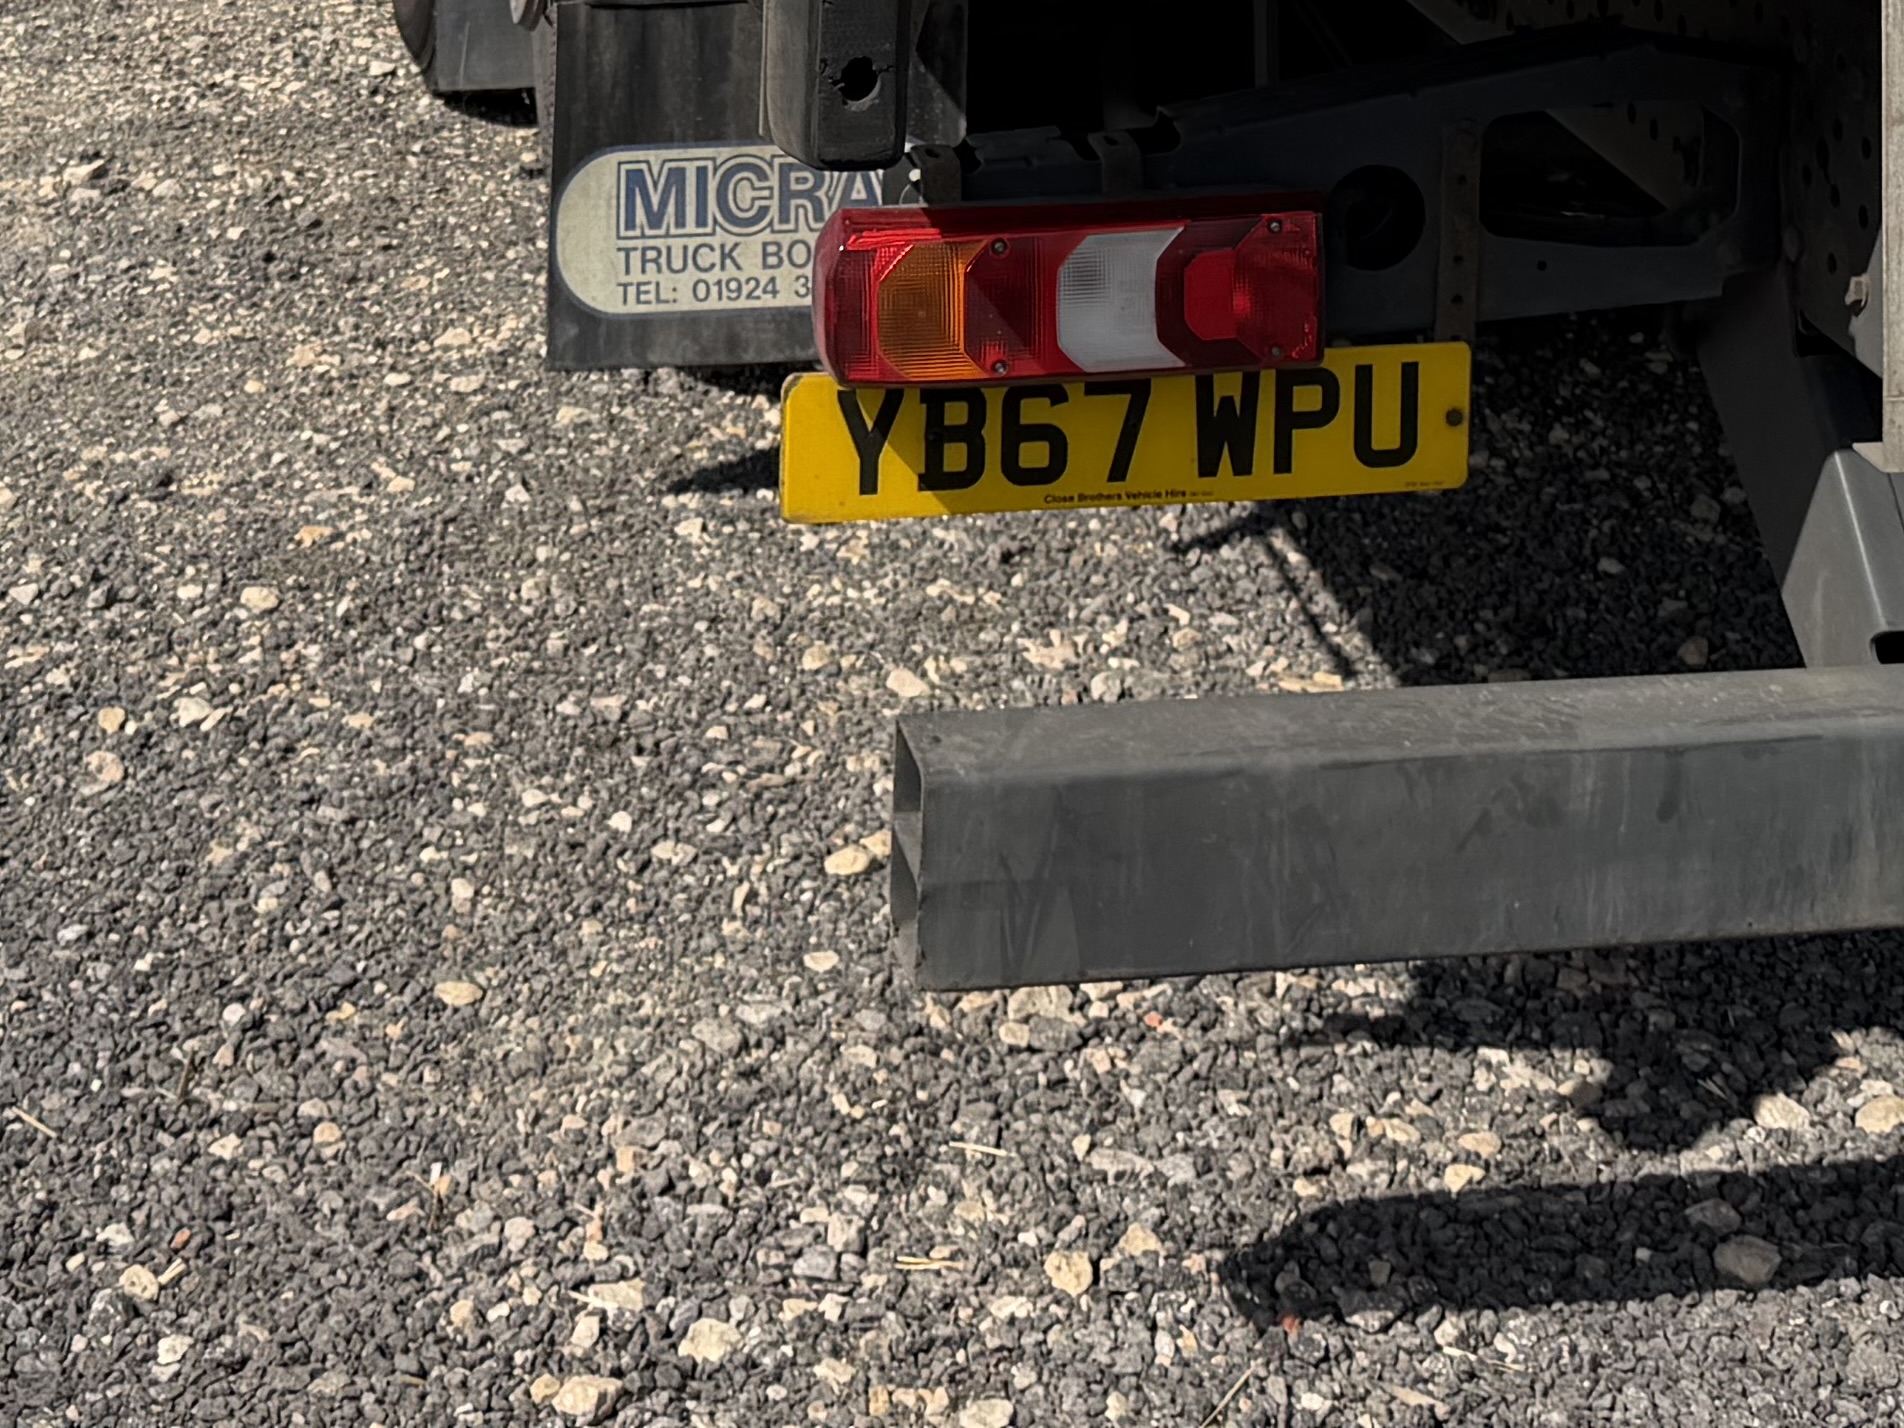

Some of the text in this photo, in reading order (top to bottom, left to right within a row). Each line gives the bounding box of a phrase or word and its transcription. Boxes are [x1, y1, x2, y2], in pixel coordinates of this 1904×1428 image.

[616, 242, 743, 276] TRUCK
[616, 281, 679, 306] TEL:
[691, 276, 780, 303] 01924
[837, 361, 1420, 496] YB67 WPU
